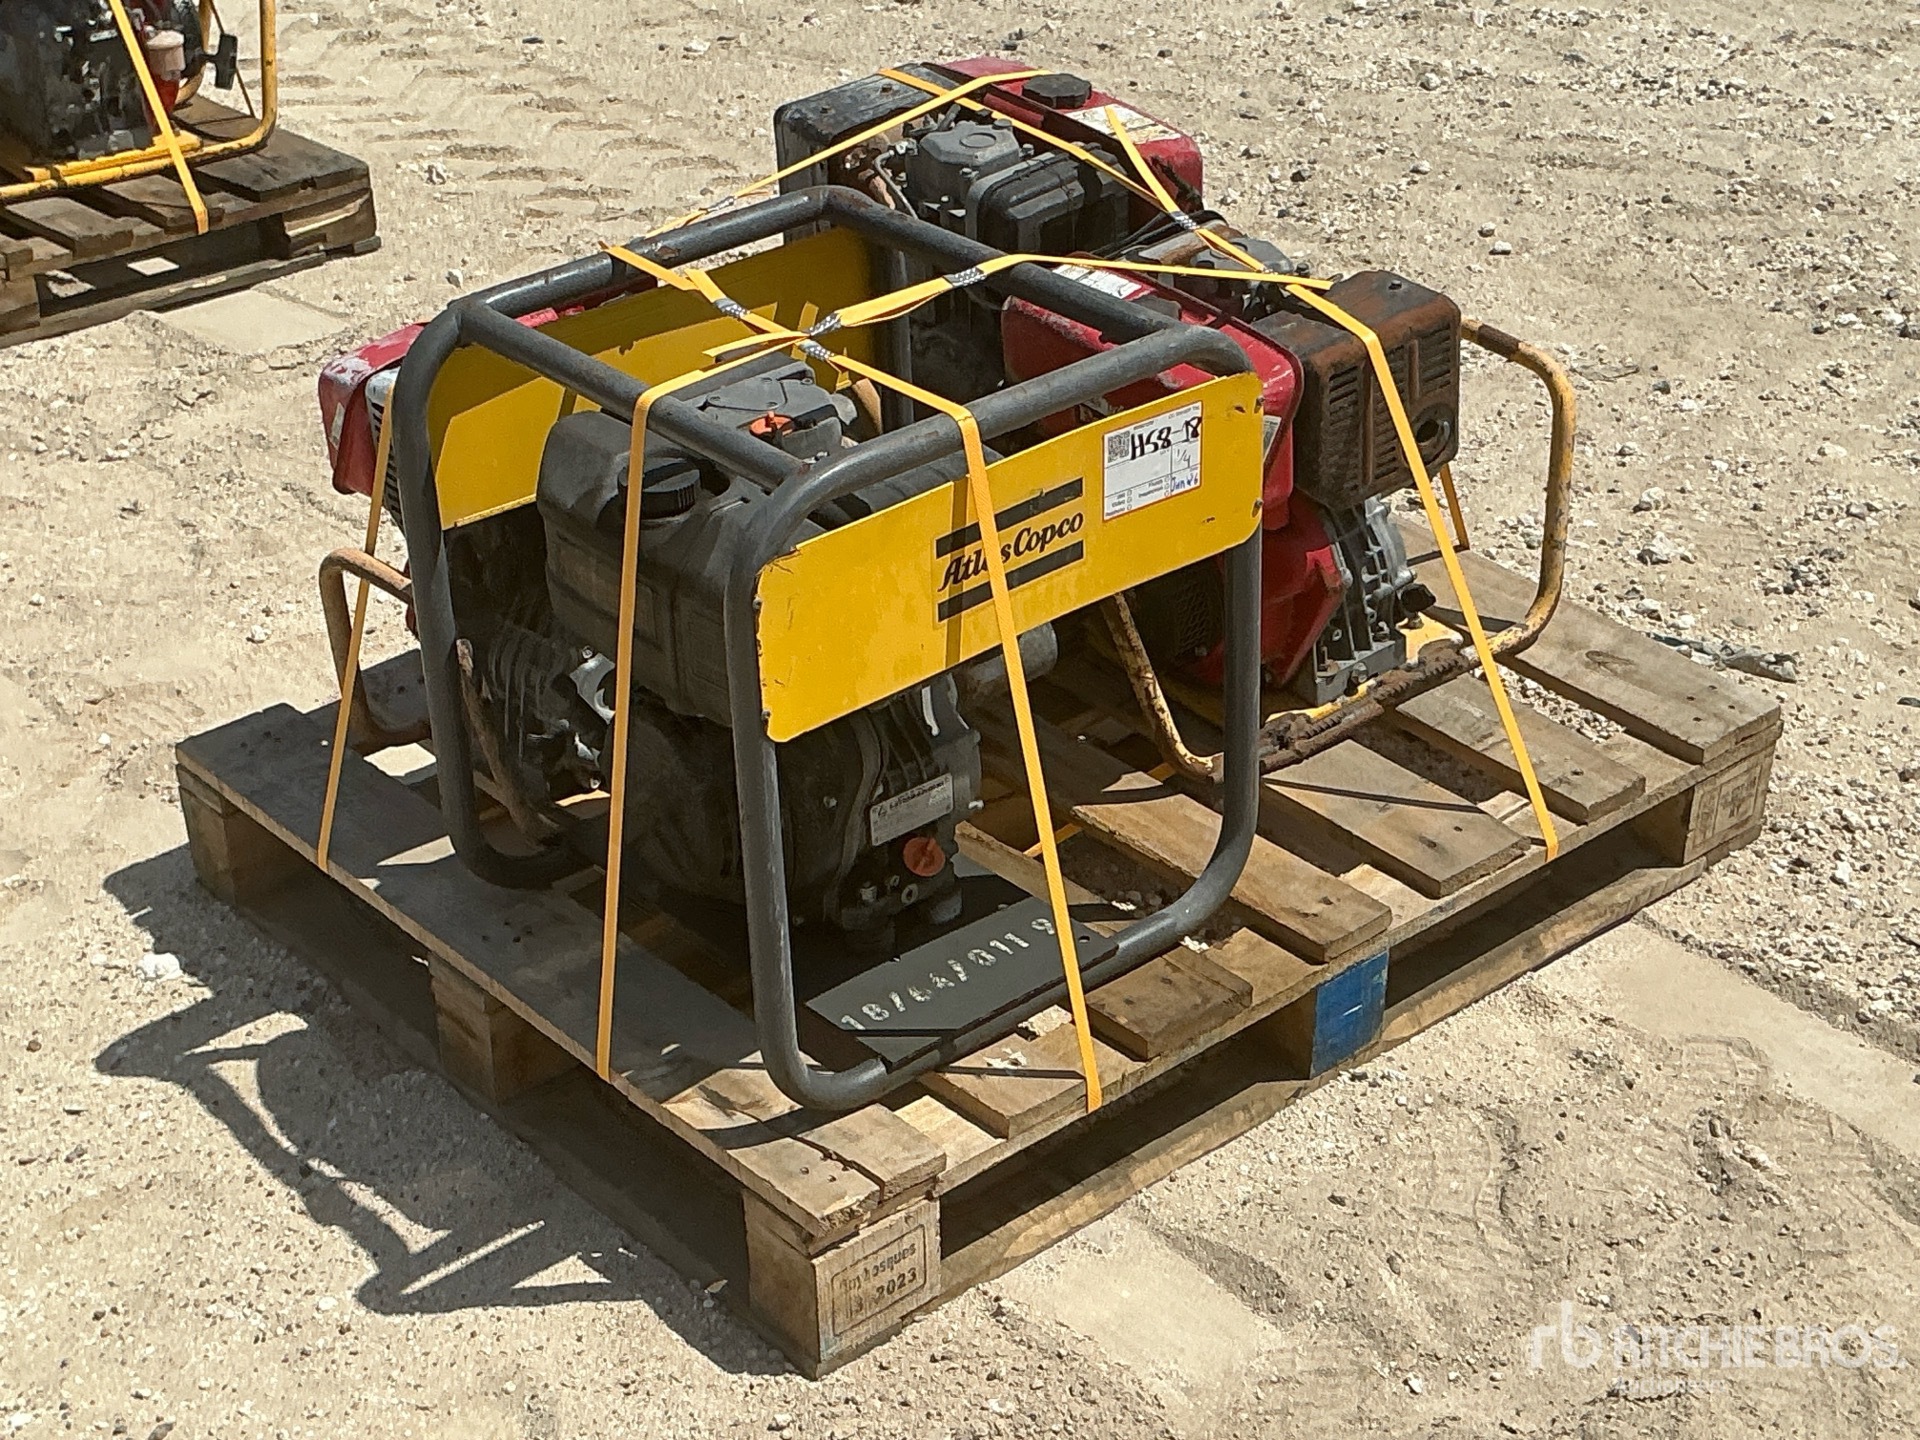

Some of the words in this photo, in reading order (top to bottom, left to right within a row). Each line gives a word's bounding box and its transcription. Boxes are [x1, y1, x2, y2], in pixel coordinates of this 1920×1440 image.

[937, 543, 1011, 592] Atls
[1013, 512, 1084, 557] Copco
[875, 1266, 917, 1302] 2023
